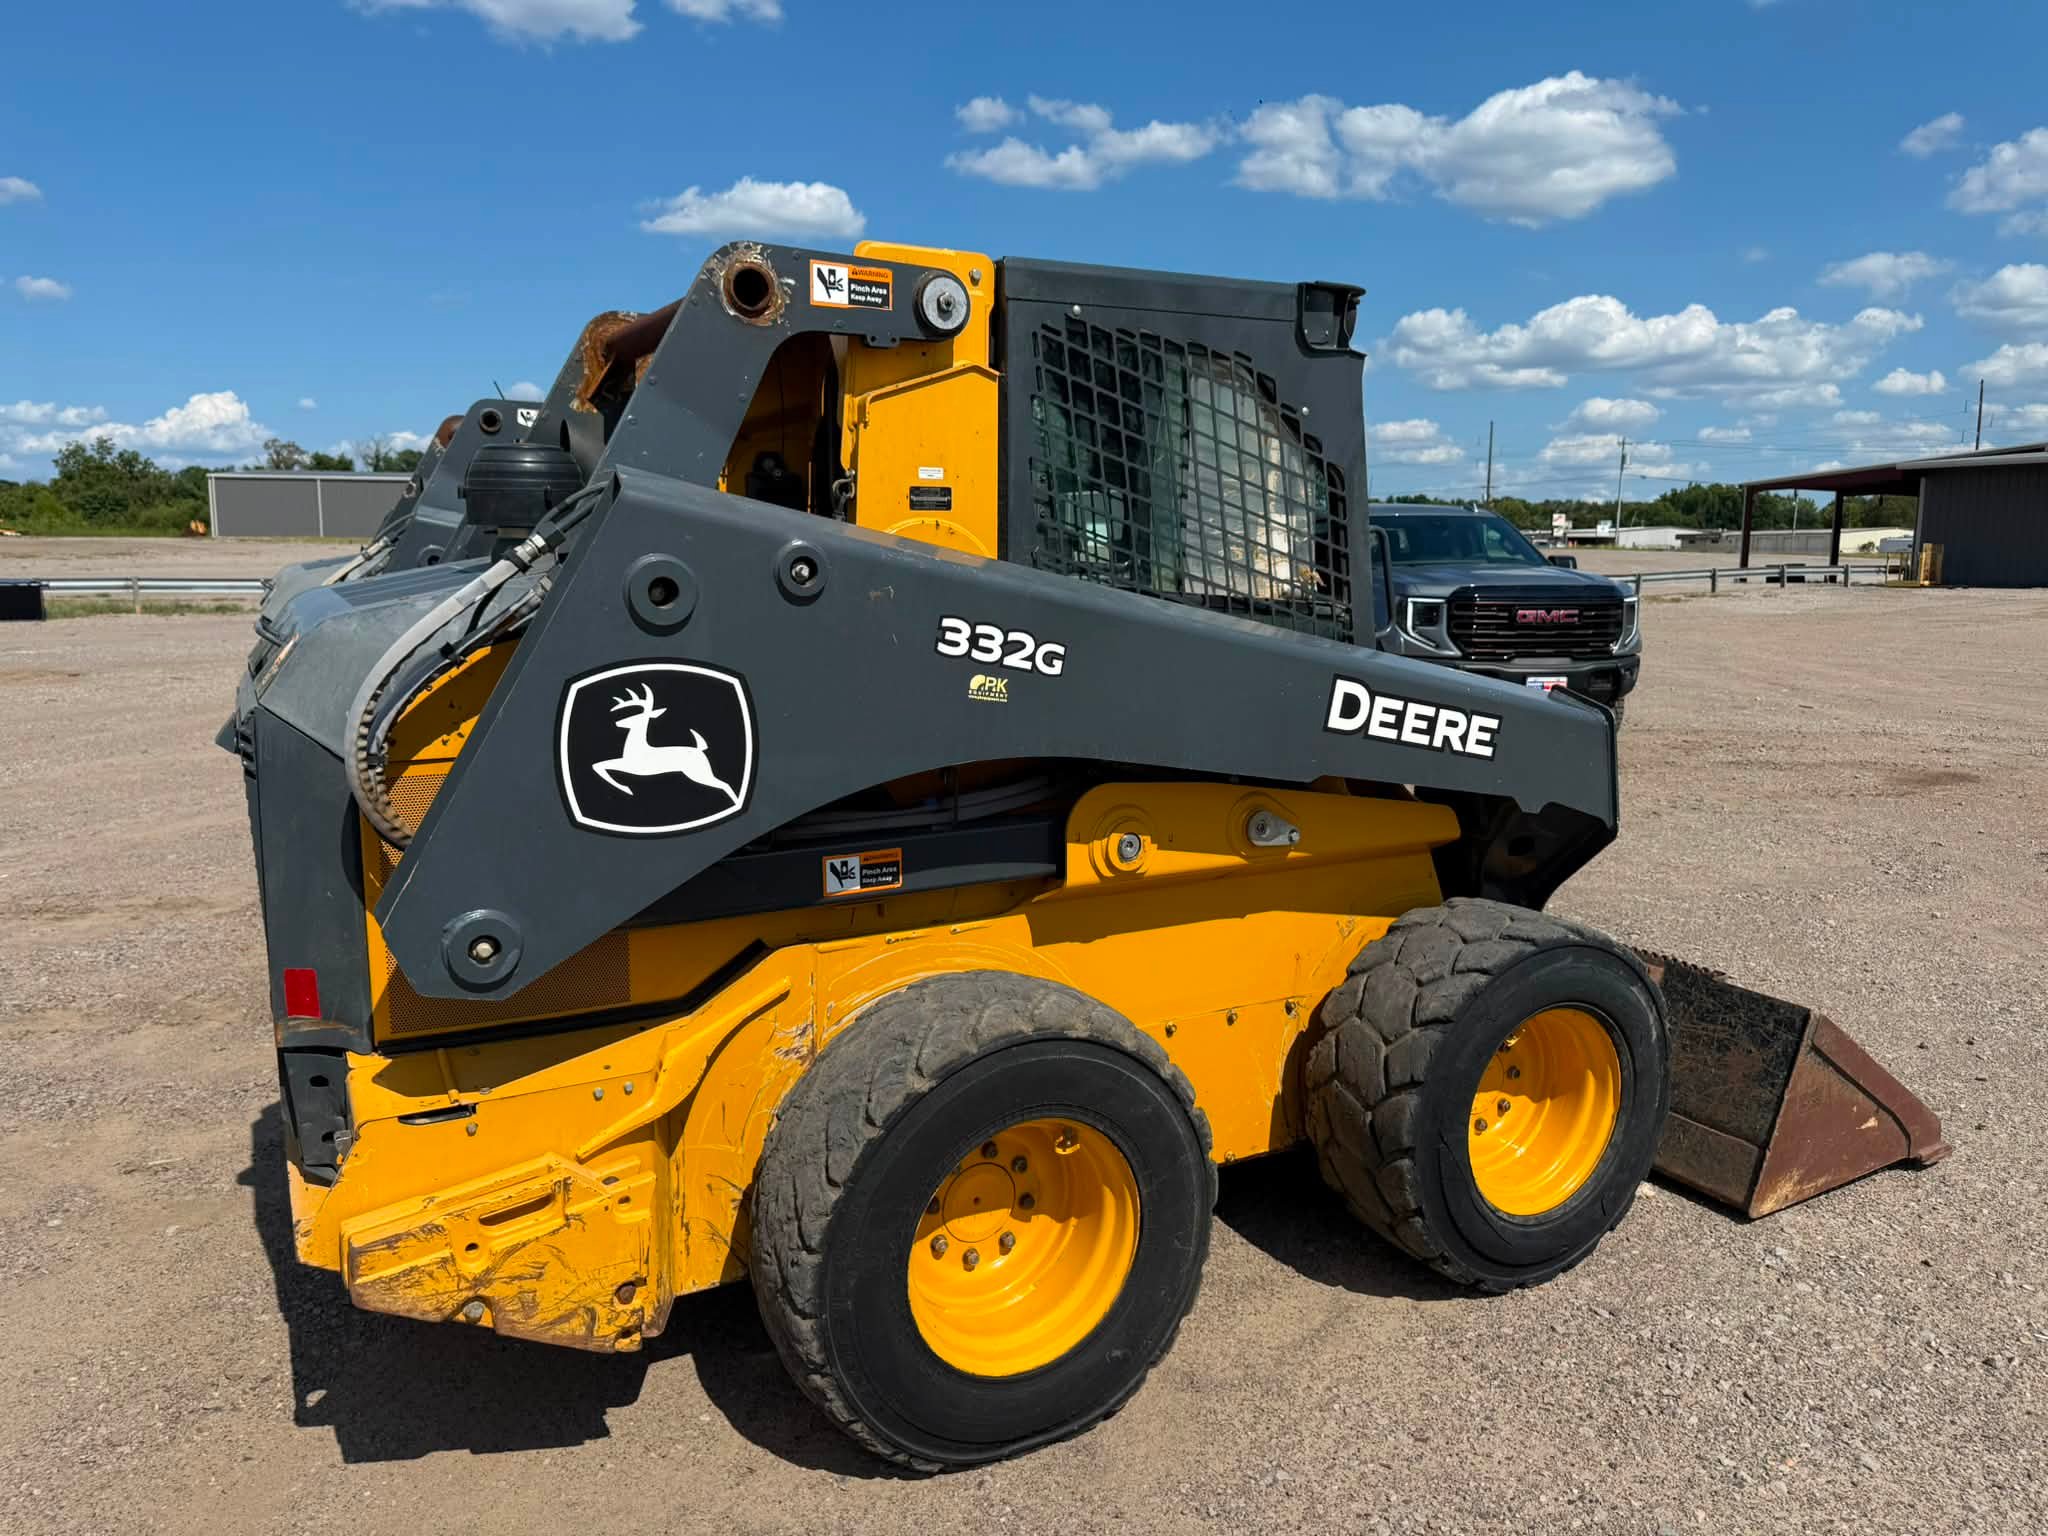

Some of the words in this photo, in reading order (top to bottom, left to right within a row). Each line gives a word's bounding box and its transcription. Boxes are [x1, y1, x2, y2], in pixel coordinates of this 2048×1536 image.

[857, 270, 889, 279] WARNING
[850, 283, 870, 293] Pinch
[871, 285, 887, 295] Area
[850, 293, 866, 302] Keep
[866, 295, 882, 304] Away
[1516, 609, 1579, 623] GMC
[936, 617, 1066, 676] 332G
[1327, 678, 1500, 757] DEERE
[862, 868, 881, 877] Pinch
[881, 866, 897, 874] Area
